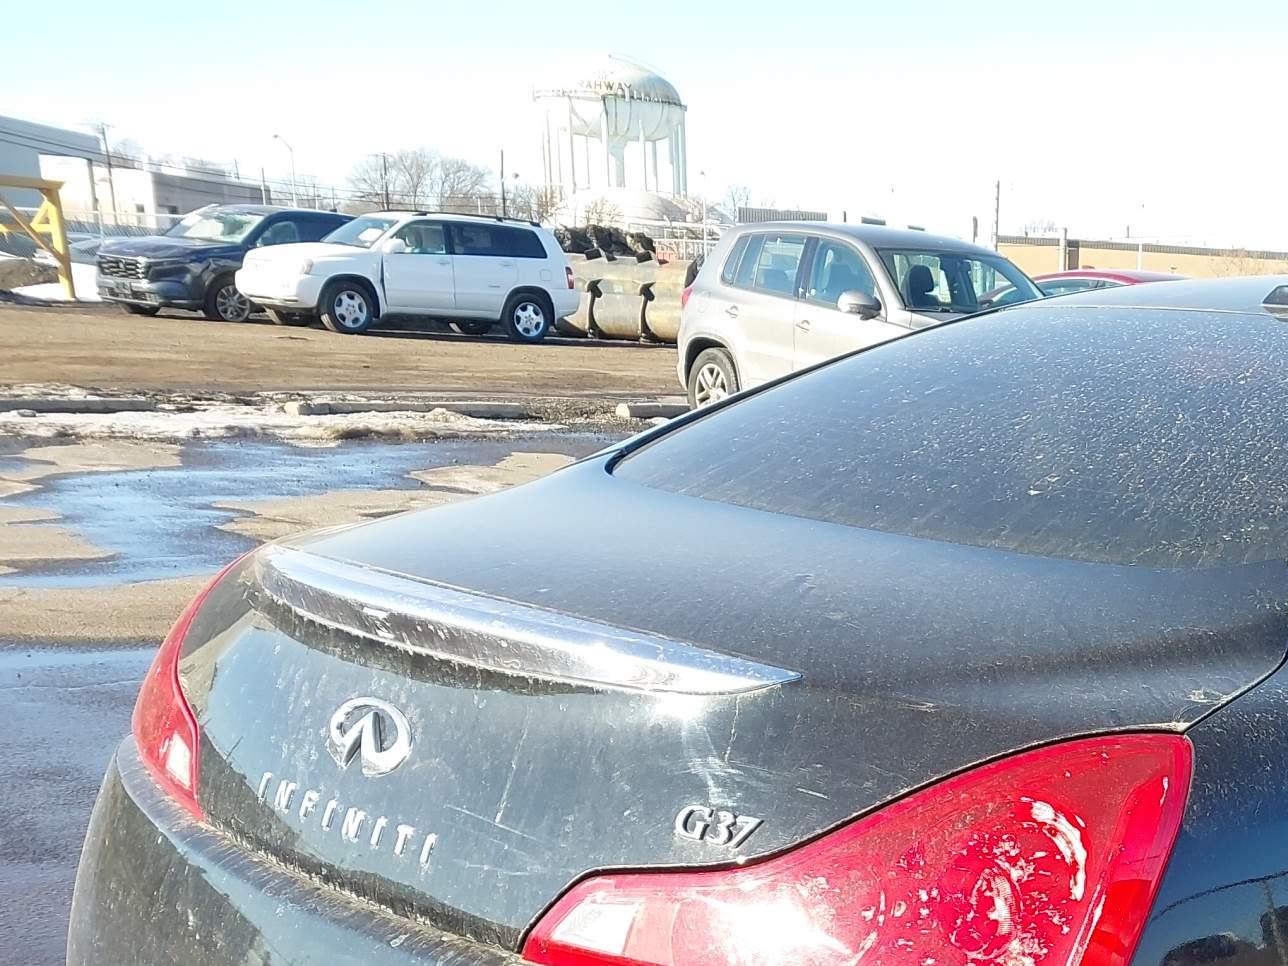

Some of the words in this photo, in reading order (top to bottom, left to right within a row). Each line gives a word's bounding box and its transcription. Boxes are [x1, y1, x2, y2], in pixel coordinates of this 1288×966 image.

[577, 80, 632, 94] RAHWAY
[257, 772, 439, 866] INFINITI
[674, 805, 764, 849] G37
